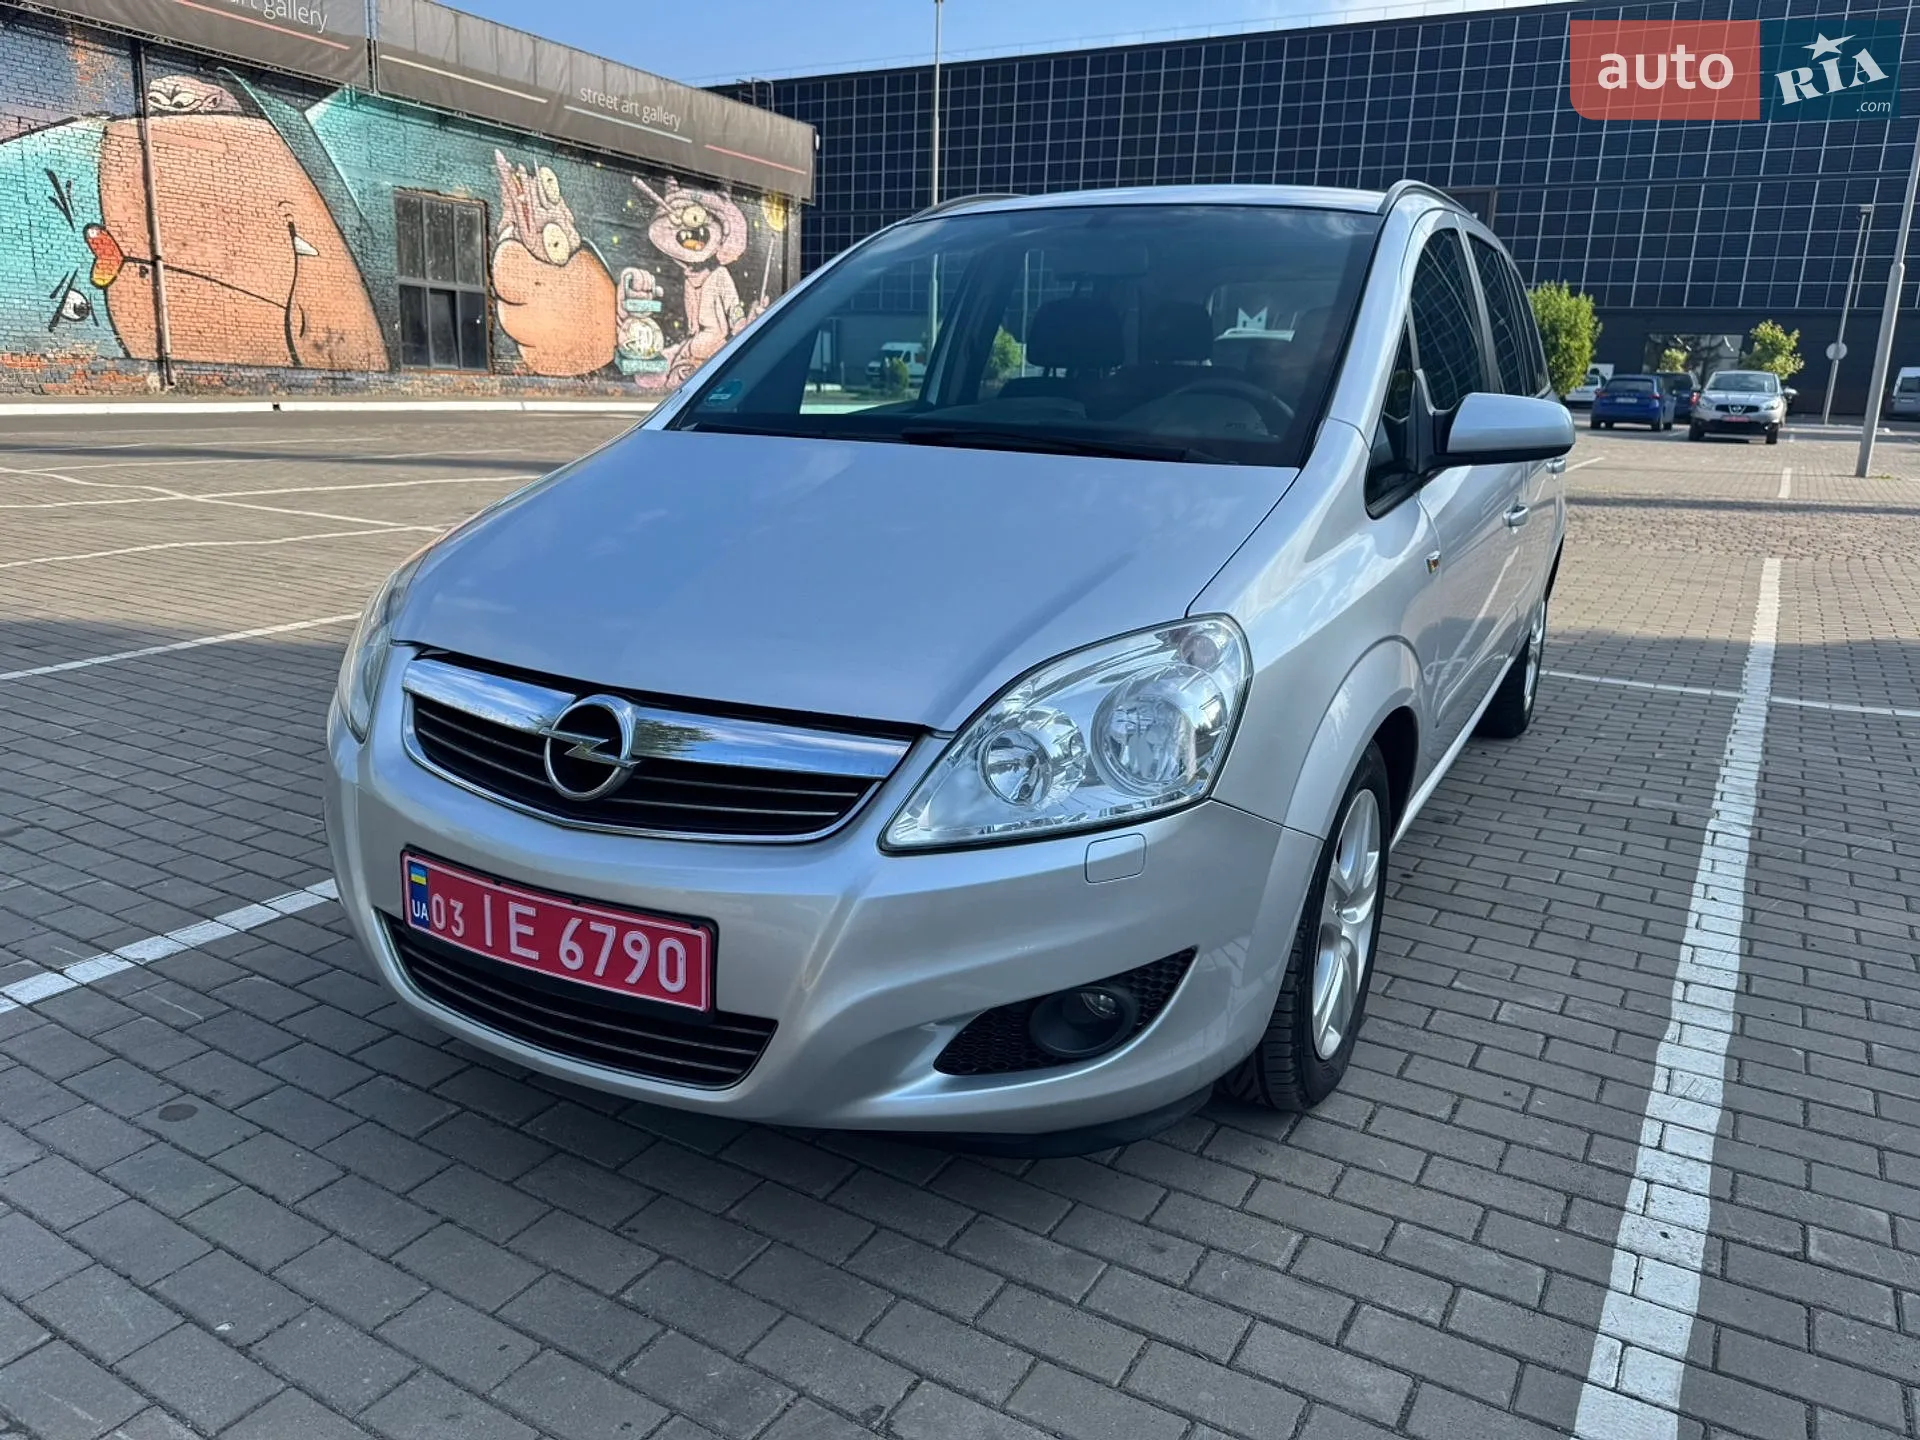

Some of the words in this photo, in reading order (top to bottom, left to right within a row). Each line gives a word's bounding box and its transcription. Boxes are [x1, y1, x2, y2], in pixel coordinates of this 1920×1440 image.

[263, 0, 328, 34] gallery
[580, 87, 619, 111] street
[621, 99, 640, 117] art
[642, 105, 681, 132] gallery
[412, 899, 430, 921] UA
[431, 893, 465, 937] 03
[484, 894, 539, 961] IE
[559, 917, 687, 993] 6790
